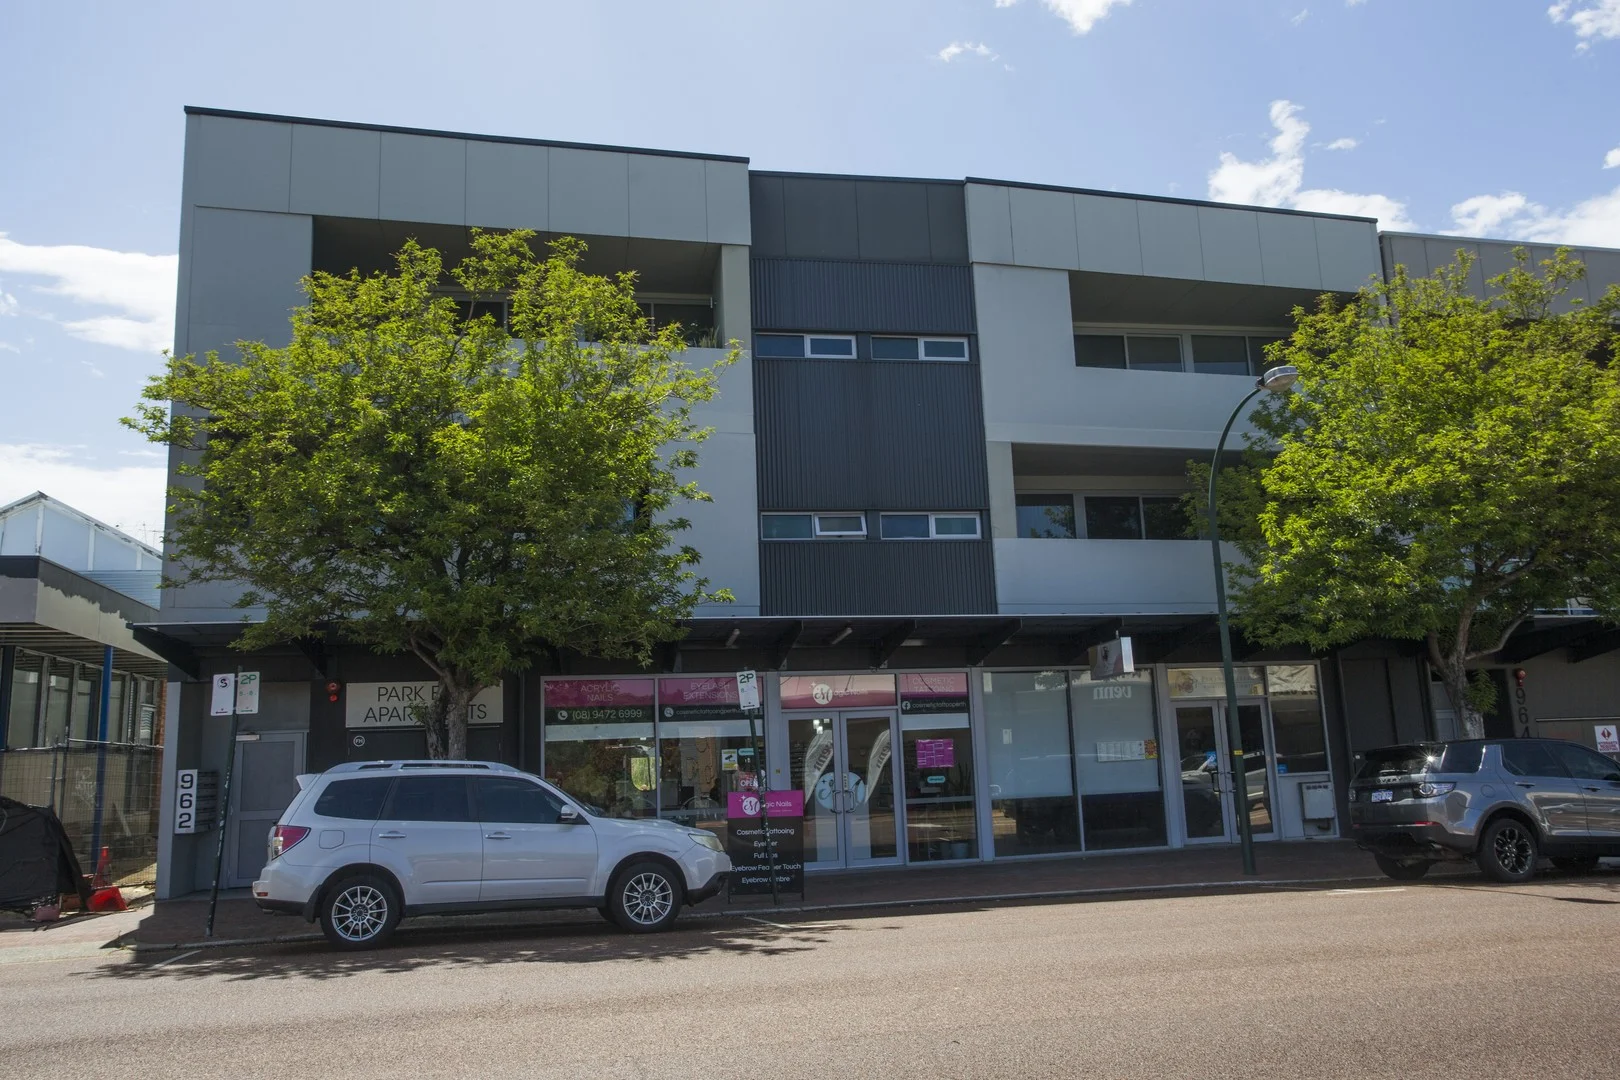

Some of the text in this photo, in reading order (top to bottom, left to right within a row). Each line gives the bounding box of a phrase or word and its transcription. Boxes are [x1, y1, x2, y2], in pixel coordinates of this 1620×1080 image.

[240, 674, 257, 685] 2P
[739, 673, 755, 684] 2P
[580, 683, 621, 693] ACRYLIC
[690, 681, 731, 690] EYELASH
[377, 685, 425, 703] PARK
[586, 693, 615, 702] NAILS
[682, 690, 738, 701] EXTENSIONS
[363, 703, 488, 723] APARTS
[572, 708, 643, 721] (08) 9472 6999
[178, 773, 194, 829] 962
[775, 800, 793, 808] Nails
[736, 828, 795, 836] Cosmetic attooing
[753, 840, 778, 848] Eyeler
[741, 877, 769, 885] Eyebrow
